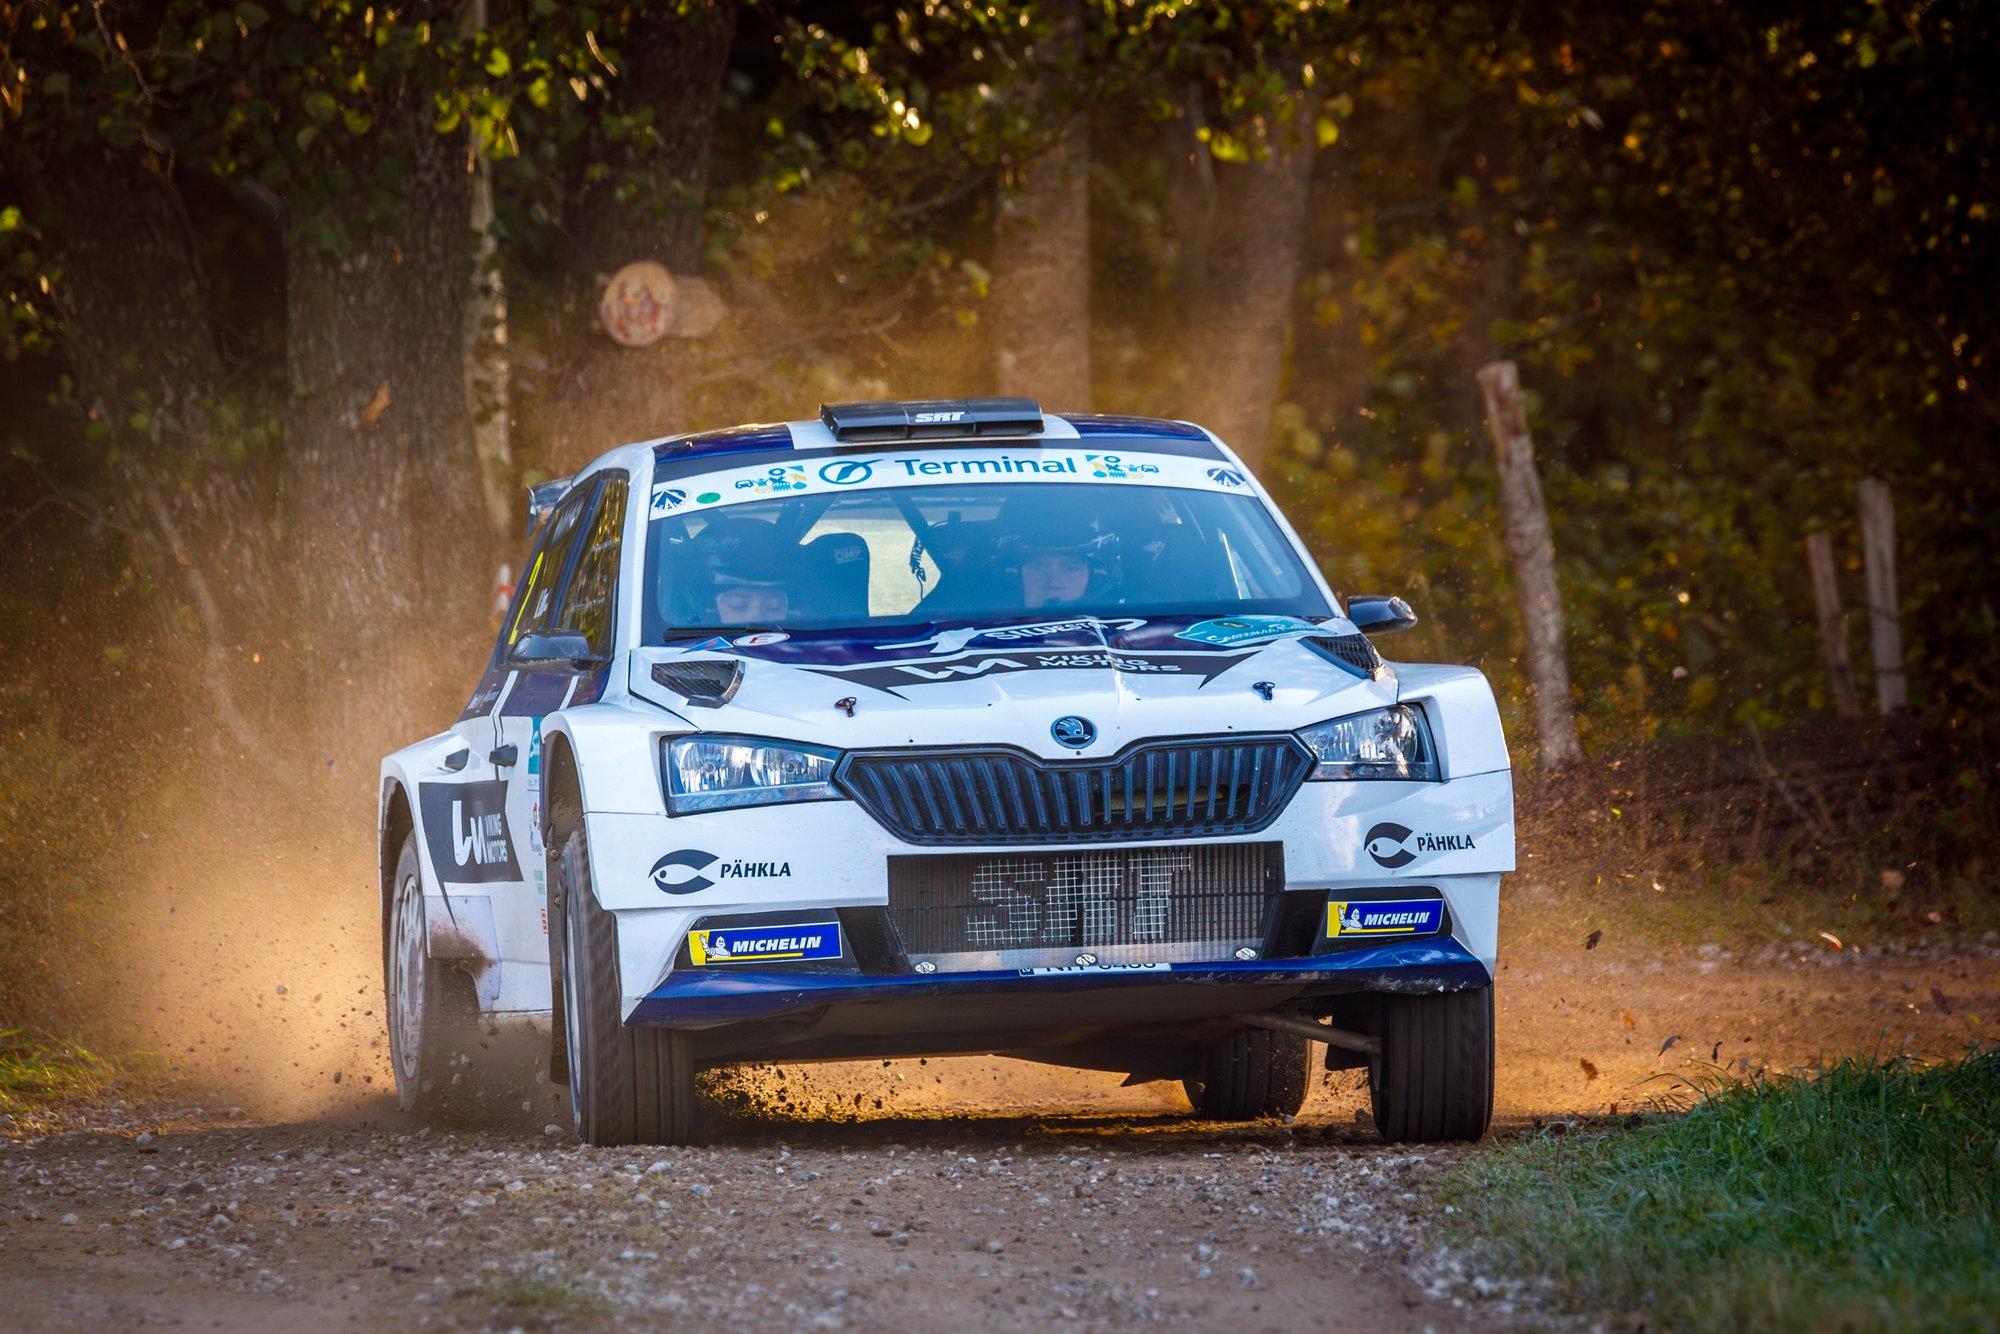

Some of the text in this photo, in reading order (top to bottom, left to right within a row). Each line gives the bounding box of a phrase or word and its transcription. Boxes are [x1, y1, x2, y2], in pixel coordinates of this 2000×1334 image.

[915, 411, 965, 422] SRT
[895, 456, 1077, 477] Terminal
[1036, 654, 1149, 666] VIKING
[1039, 660, 1182, 671] MOTORS
[1417, 833, 1476, 851] PÄHKLA
[720, 859, 791, 878] PÄHKLA
[1364, 912, 1430, 926] MICHELIN
[732, 936, 821, 953] MICHELIN
